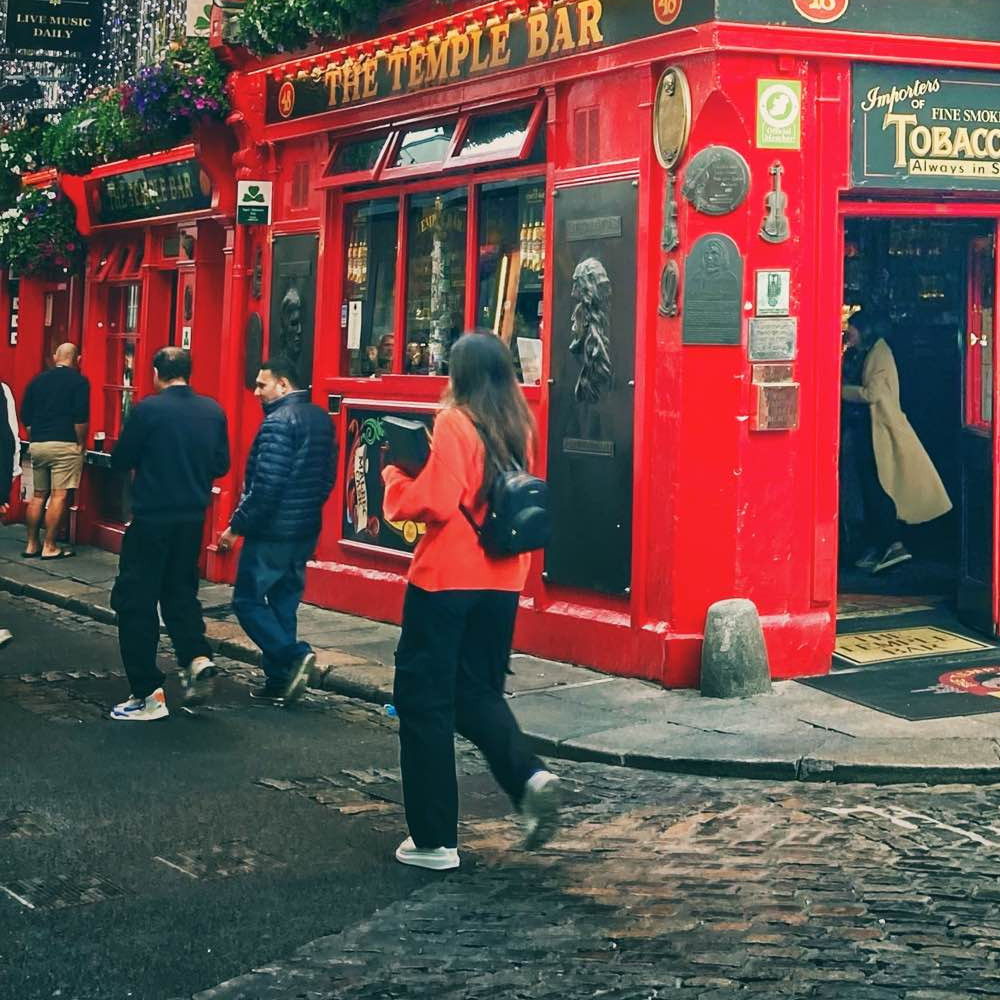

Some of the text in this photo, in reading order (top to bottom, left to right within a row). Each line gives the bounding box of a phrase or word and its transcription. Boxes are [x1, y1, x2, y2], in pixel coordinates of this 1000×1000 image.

[16, 13, 92, 27] LIVE MUSIC
[33, 27, 74, 39] DAILY
[325, 57, 379, 106] THE
[389, 22, 511, 92] TEMPLE
[861, 78, 941, 113] Importers
[911, 99, 926, 109] OF
[931, 107, 961, 121] FINE
[912, 160, 965, 174] Always
[973, 163, 985, 174] in
